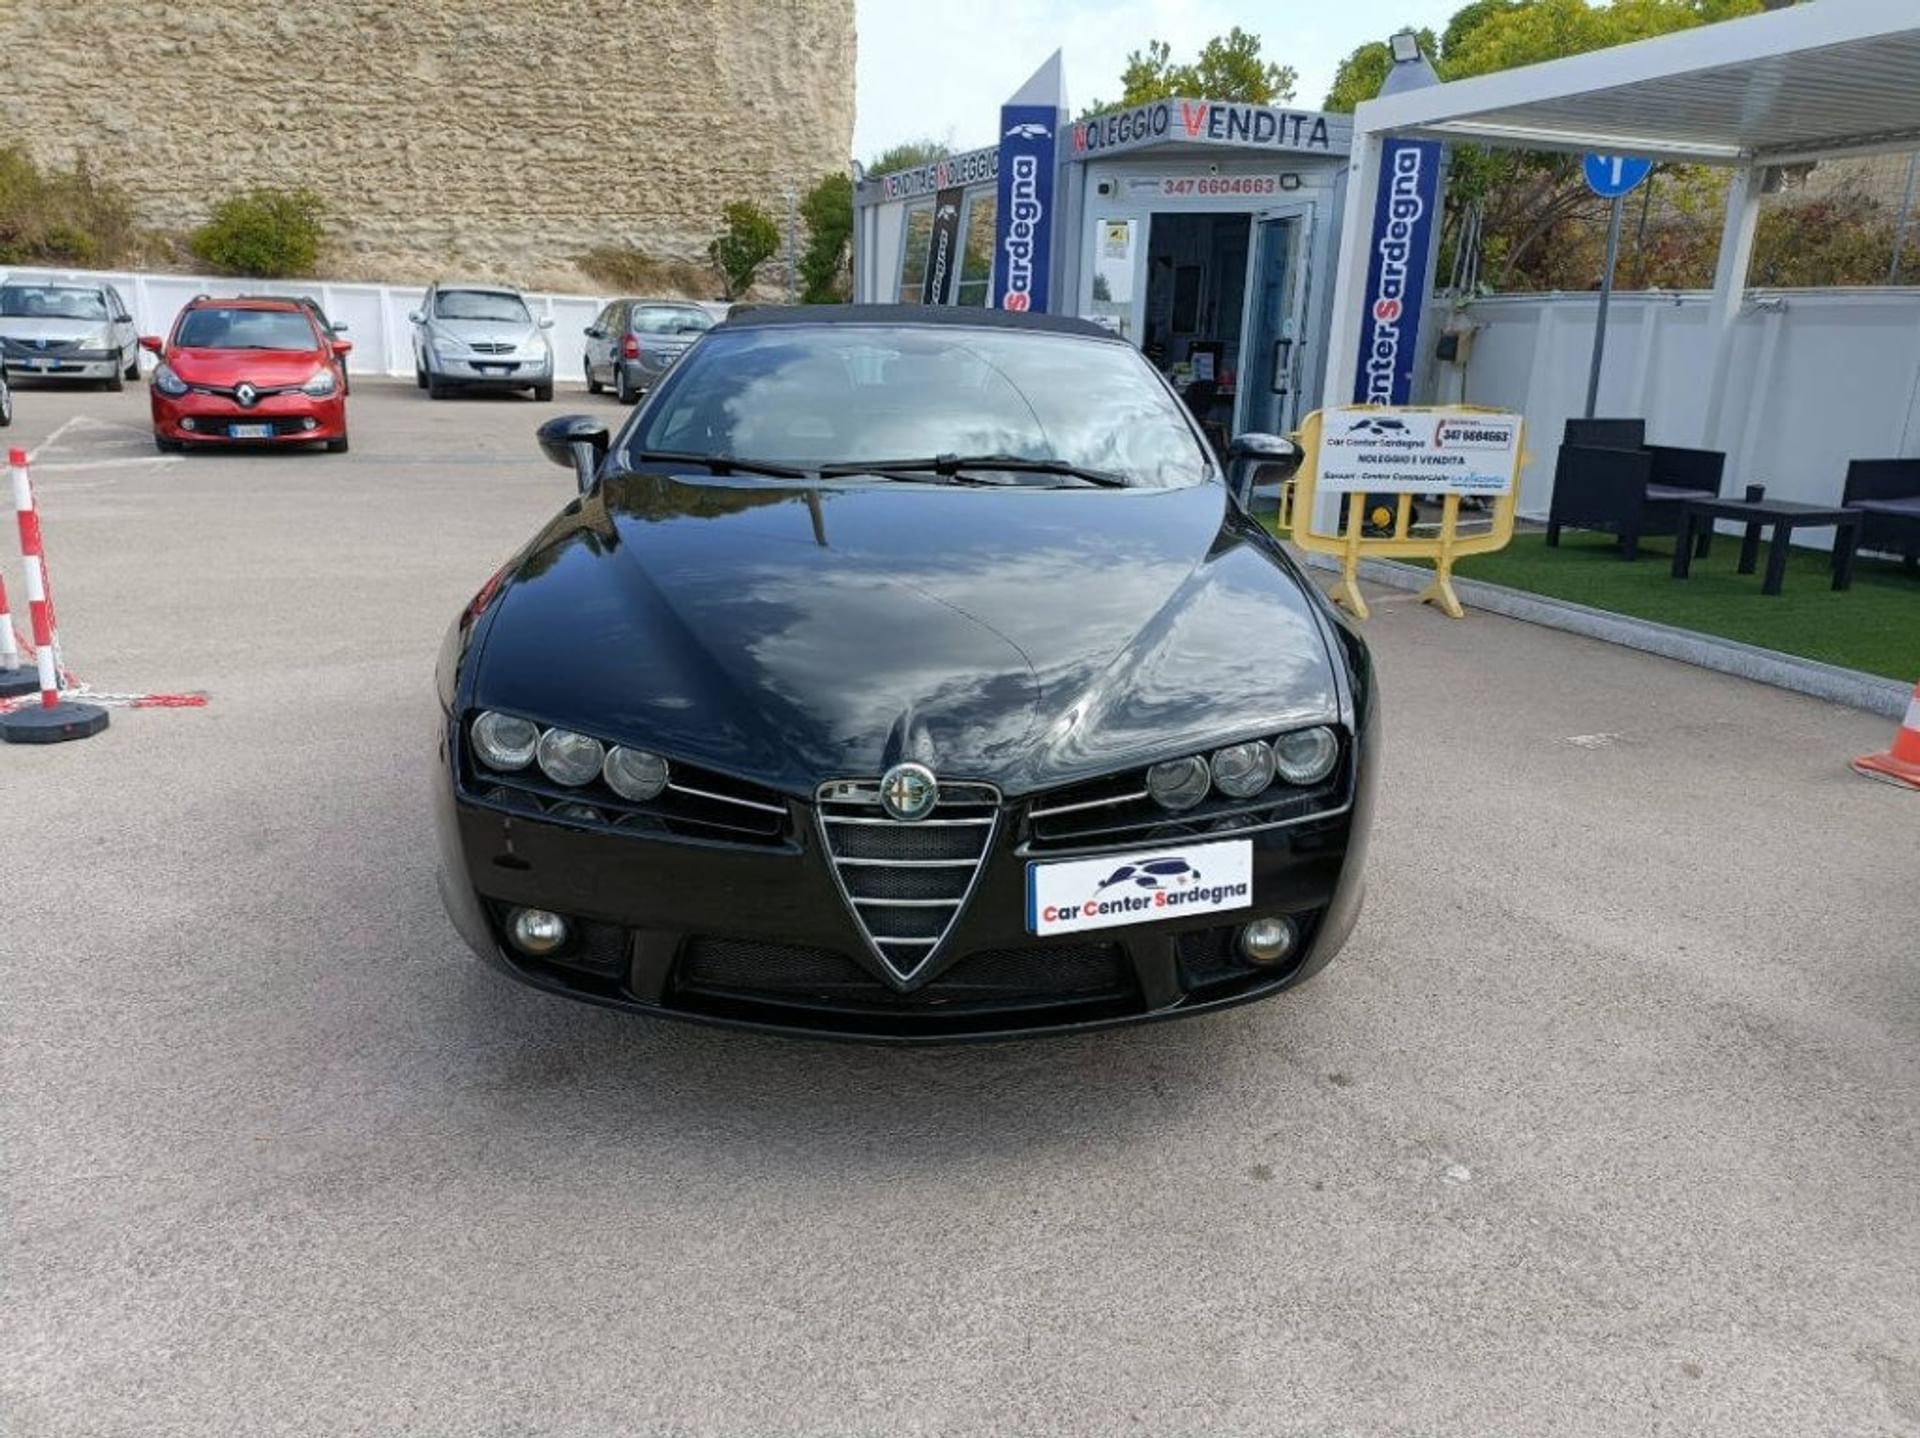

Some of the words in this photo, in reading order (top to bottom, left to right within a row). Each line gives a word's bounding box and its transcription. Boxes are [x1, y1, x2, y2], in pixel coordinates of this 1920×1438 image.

[1073, 104, 1169, 152] NOLEGGIO
[1180, 102, 1329, 149] VENDITA
[1004, 155, 1042, 311] Sardegna
[1358, 454, 1411, 464] NOLEGGIO
[1419, 455, 1466, 465] VENDITA
[1043, 903, 1080, 922] Car
[1083, 895, 1151, 917] Center
[1154, 882, 1247, 907] Sardegna
